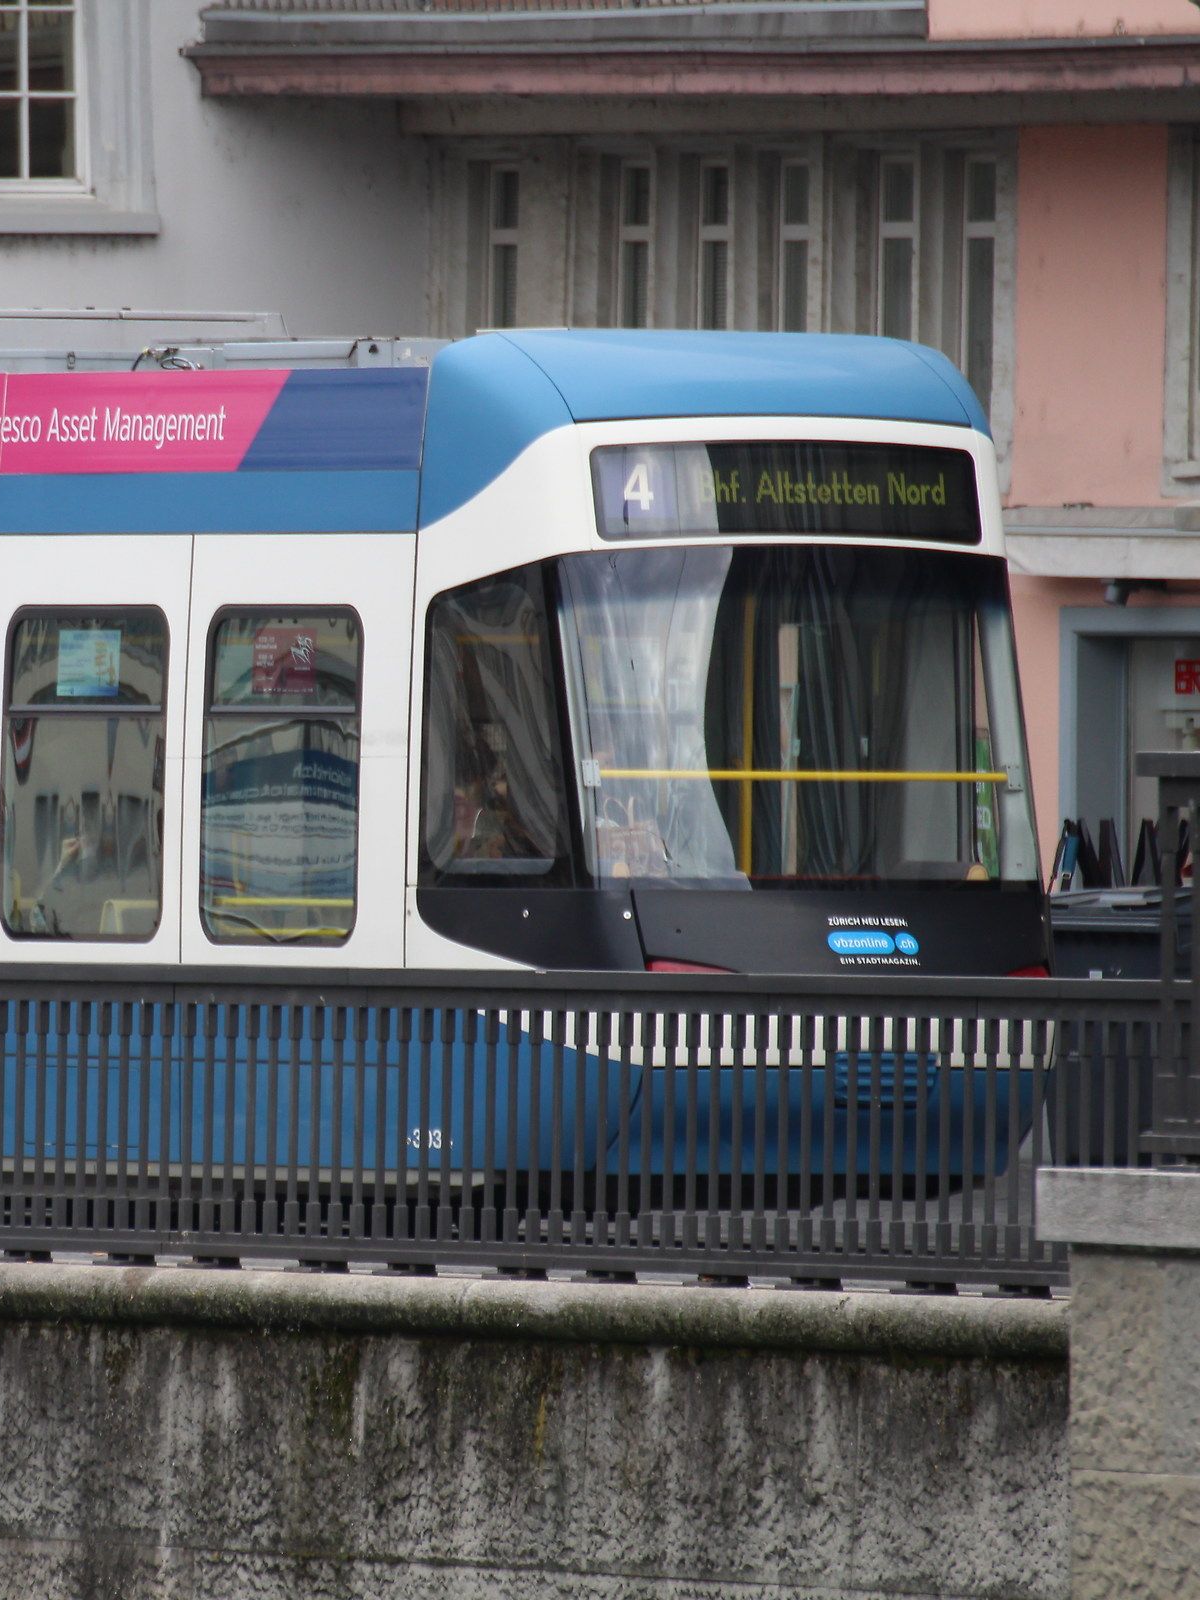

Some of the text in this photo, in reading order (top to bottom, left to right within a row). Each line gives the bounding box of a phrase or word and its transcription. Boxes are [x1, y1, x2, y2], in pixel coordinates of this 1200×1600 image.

[46, 406, 98, 442] Asset
[103, 405, 226, 450] Management
[623, 463, 655, 511] 4
[702, 470, 947, 506] Bhf. Altstetten Nord
[828, 916, 861, 926] ZÜRICH
[862, 918, 879, 926] NEU
[833, 938, 888, 949] vbzonline
[840, 957, 920, 966] EIN STADTMAGAZIN.
